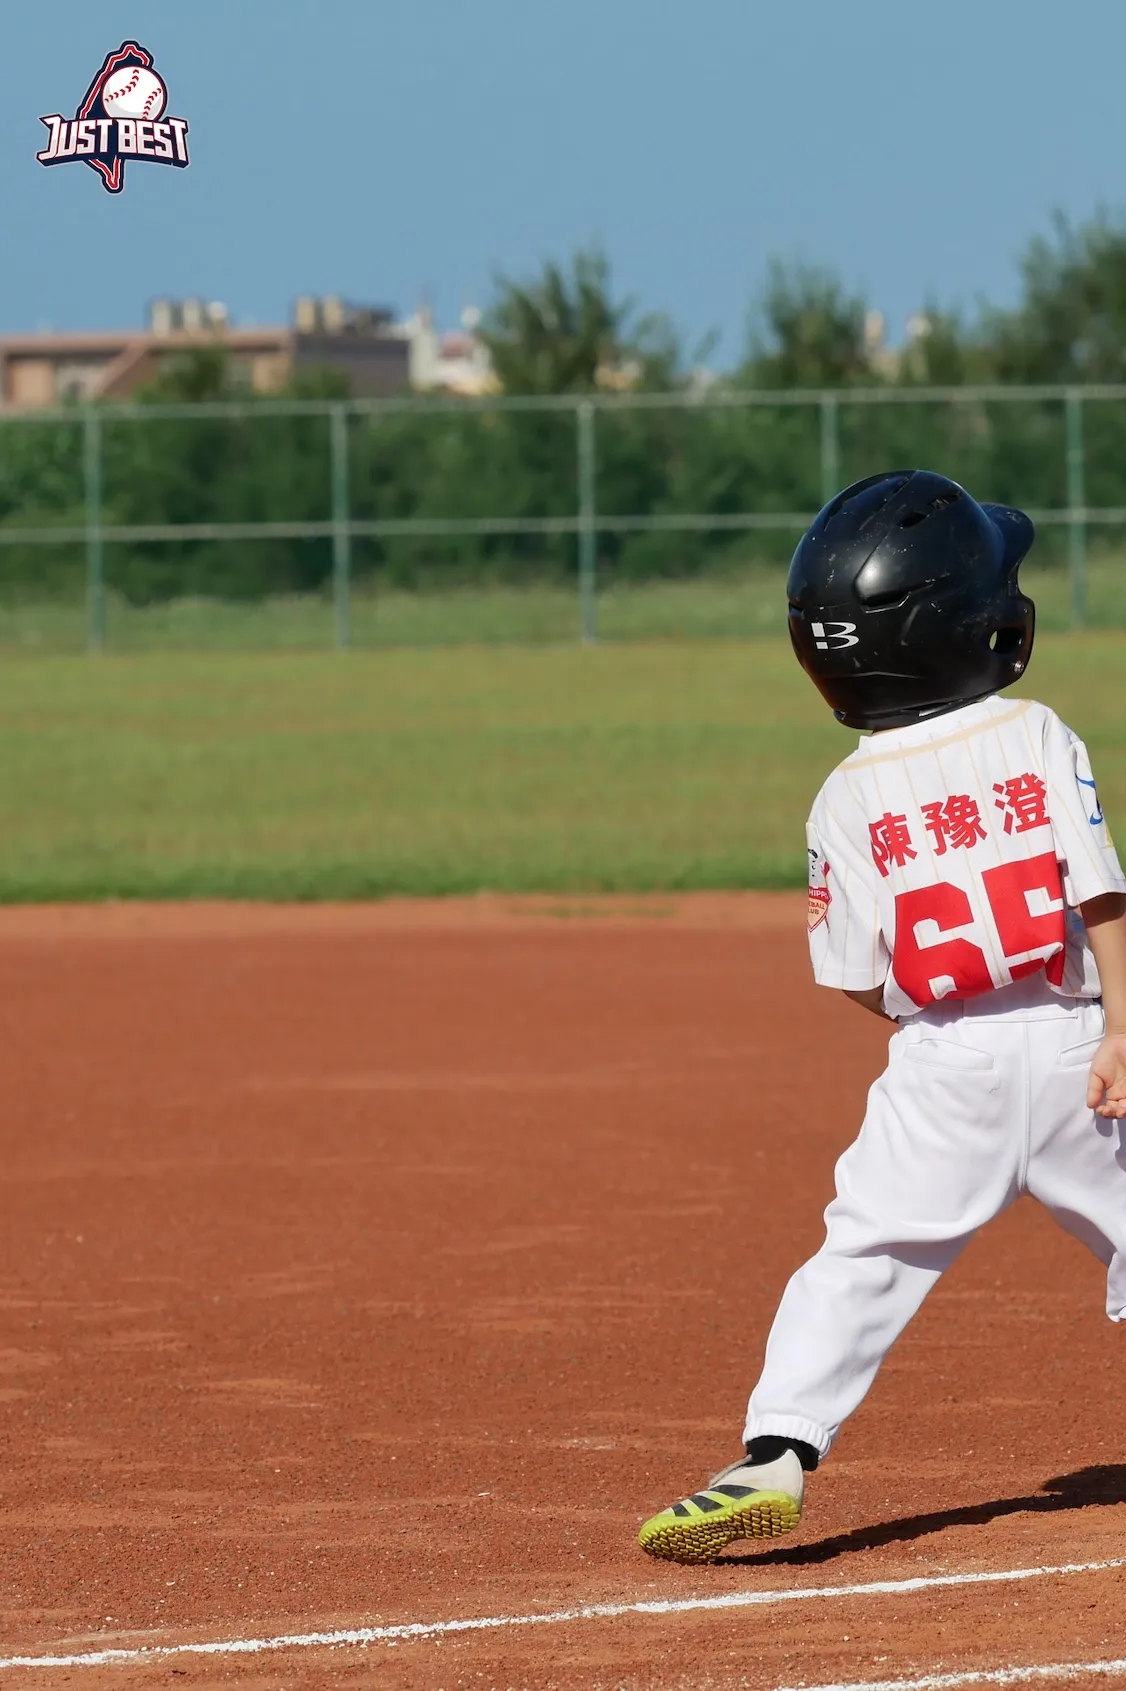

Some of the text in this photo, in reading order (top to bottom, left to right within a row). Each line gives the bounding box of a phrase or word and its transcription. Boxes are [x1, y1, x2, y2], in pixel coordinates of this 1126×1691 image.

[868, 772, 1051, 878] 陳豫澄
[891, 850, 1066, 1009] 65
